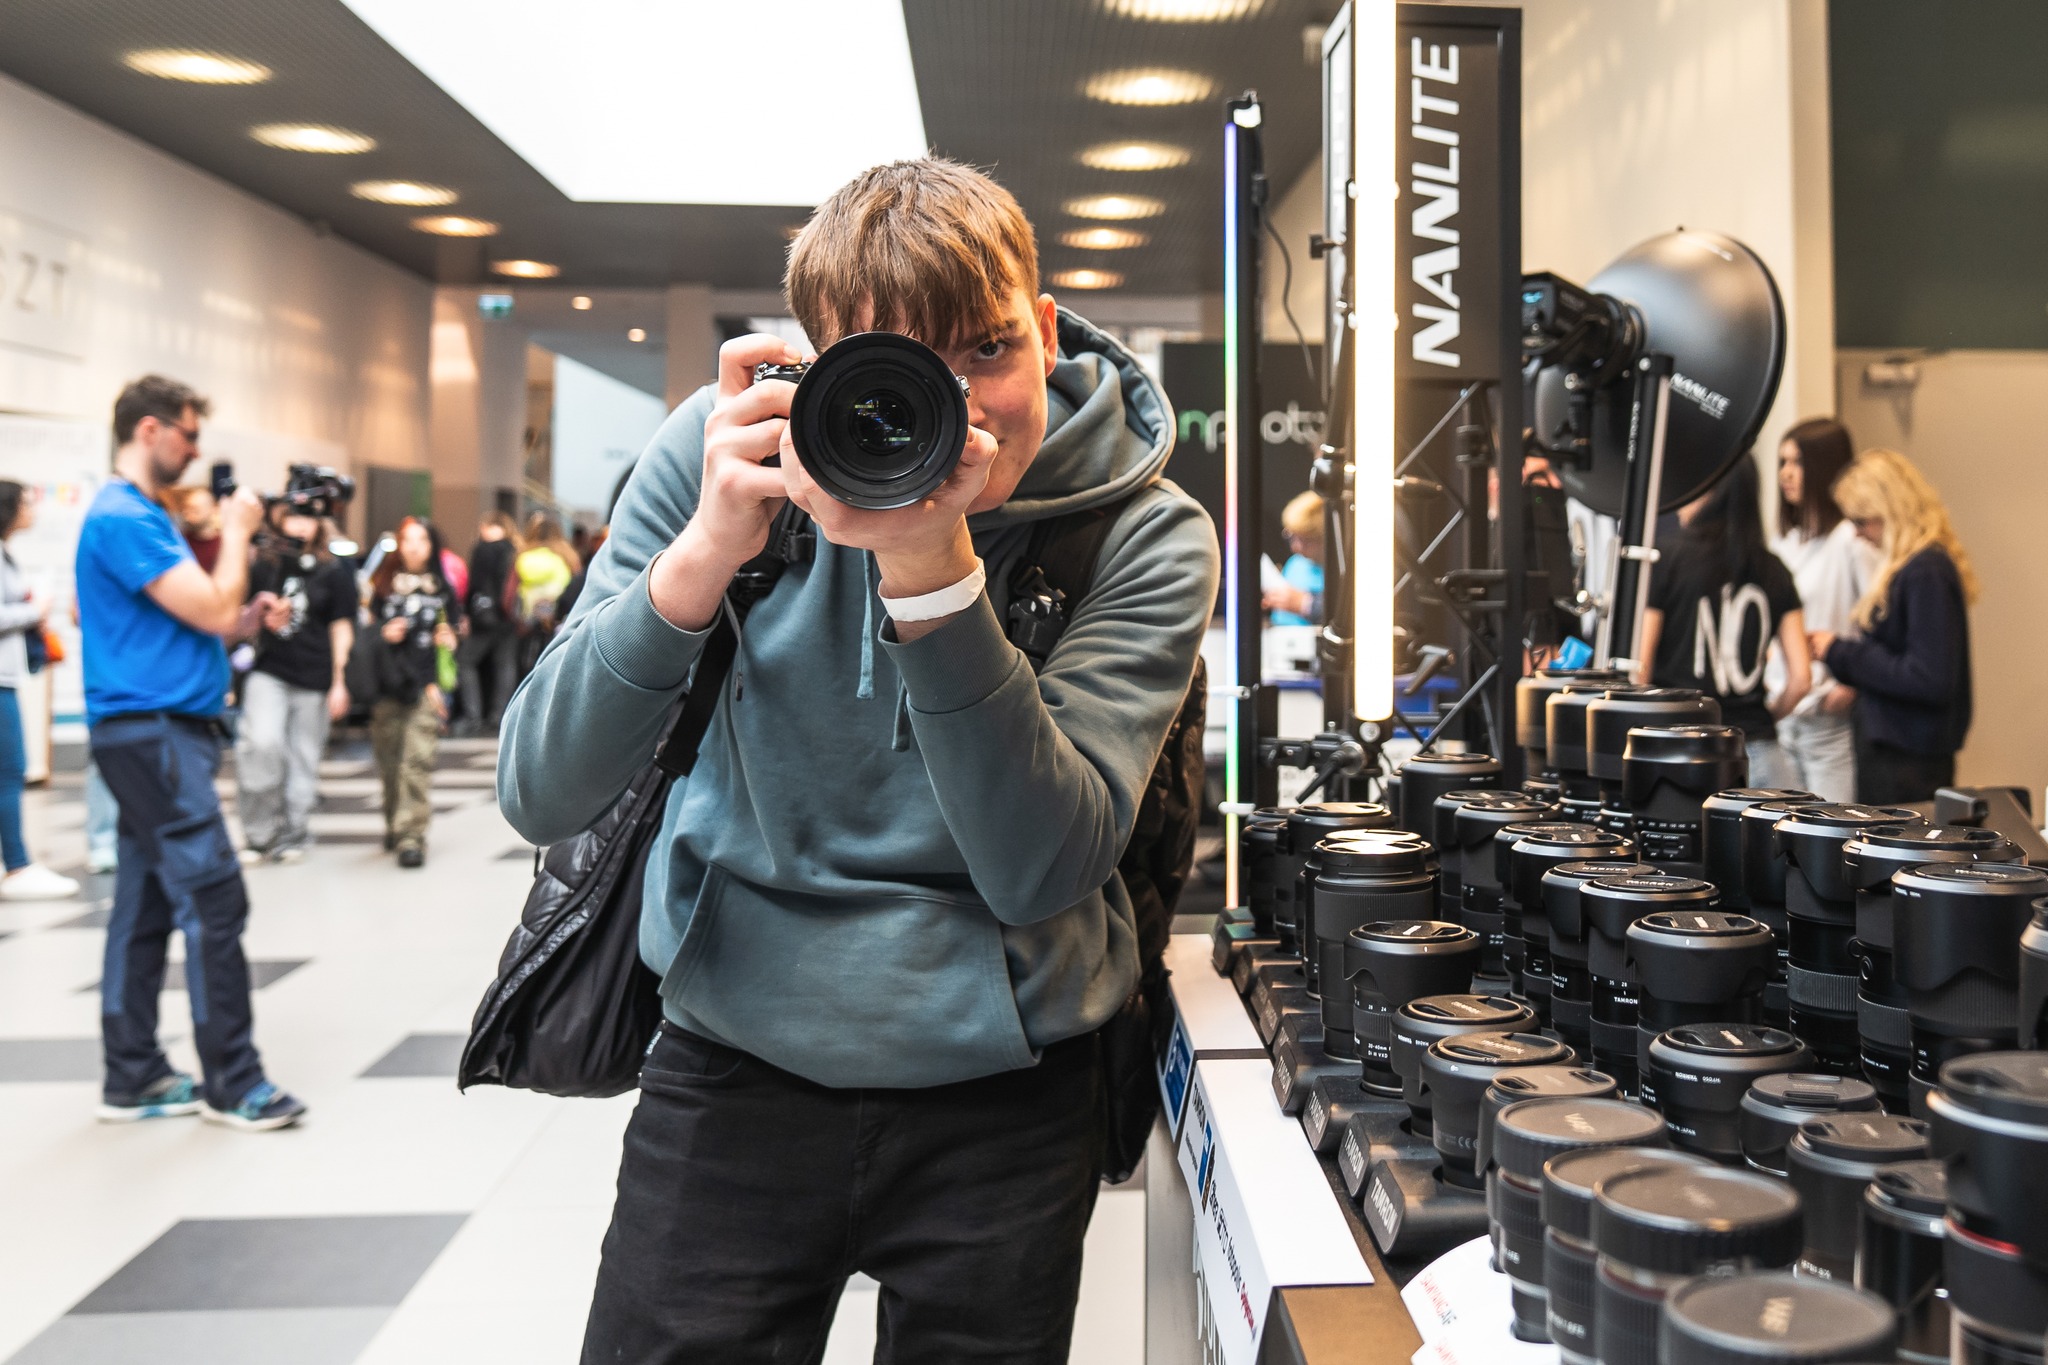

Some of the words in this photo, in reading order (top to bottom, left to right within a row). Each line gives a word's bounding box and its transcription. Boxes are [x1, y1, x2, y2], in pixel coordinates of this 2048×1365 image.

[1411, 36, 1461, 368] NANLITE
[1693, 582, 1771, 696] NO
[1613, 996, 1638, 1005] TAMRON
[1276, 1055, 1293, 1094] TAMRON
[1306, 1091, 1328, 1135] TAMRON
[1344, 1129, 1365, 1179] TAMRON
[1371, 1176, 1399, 1235] TAMRON
